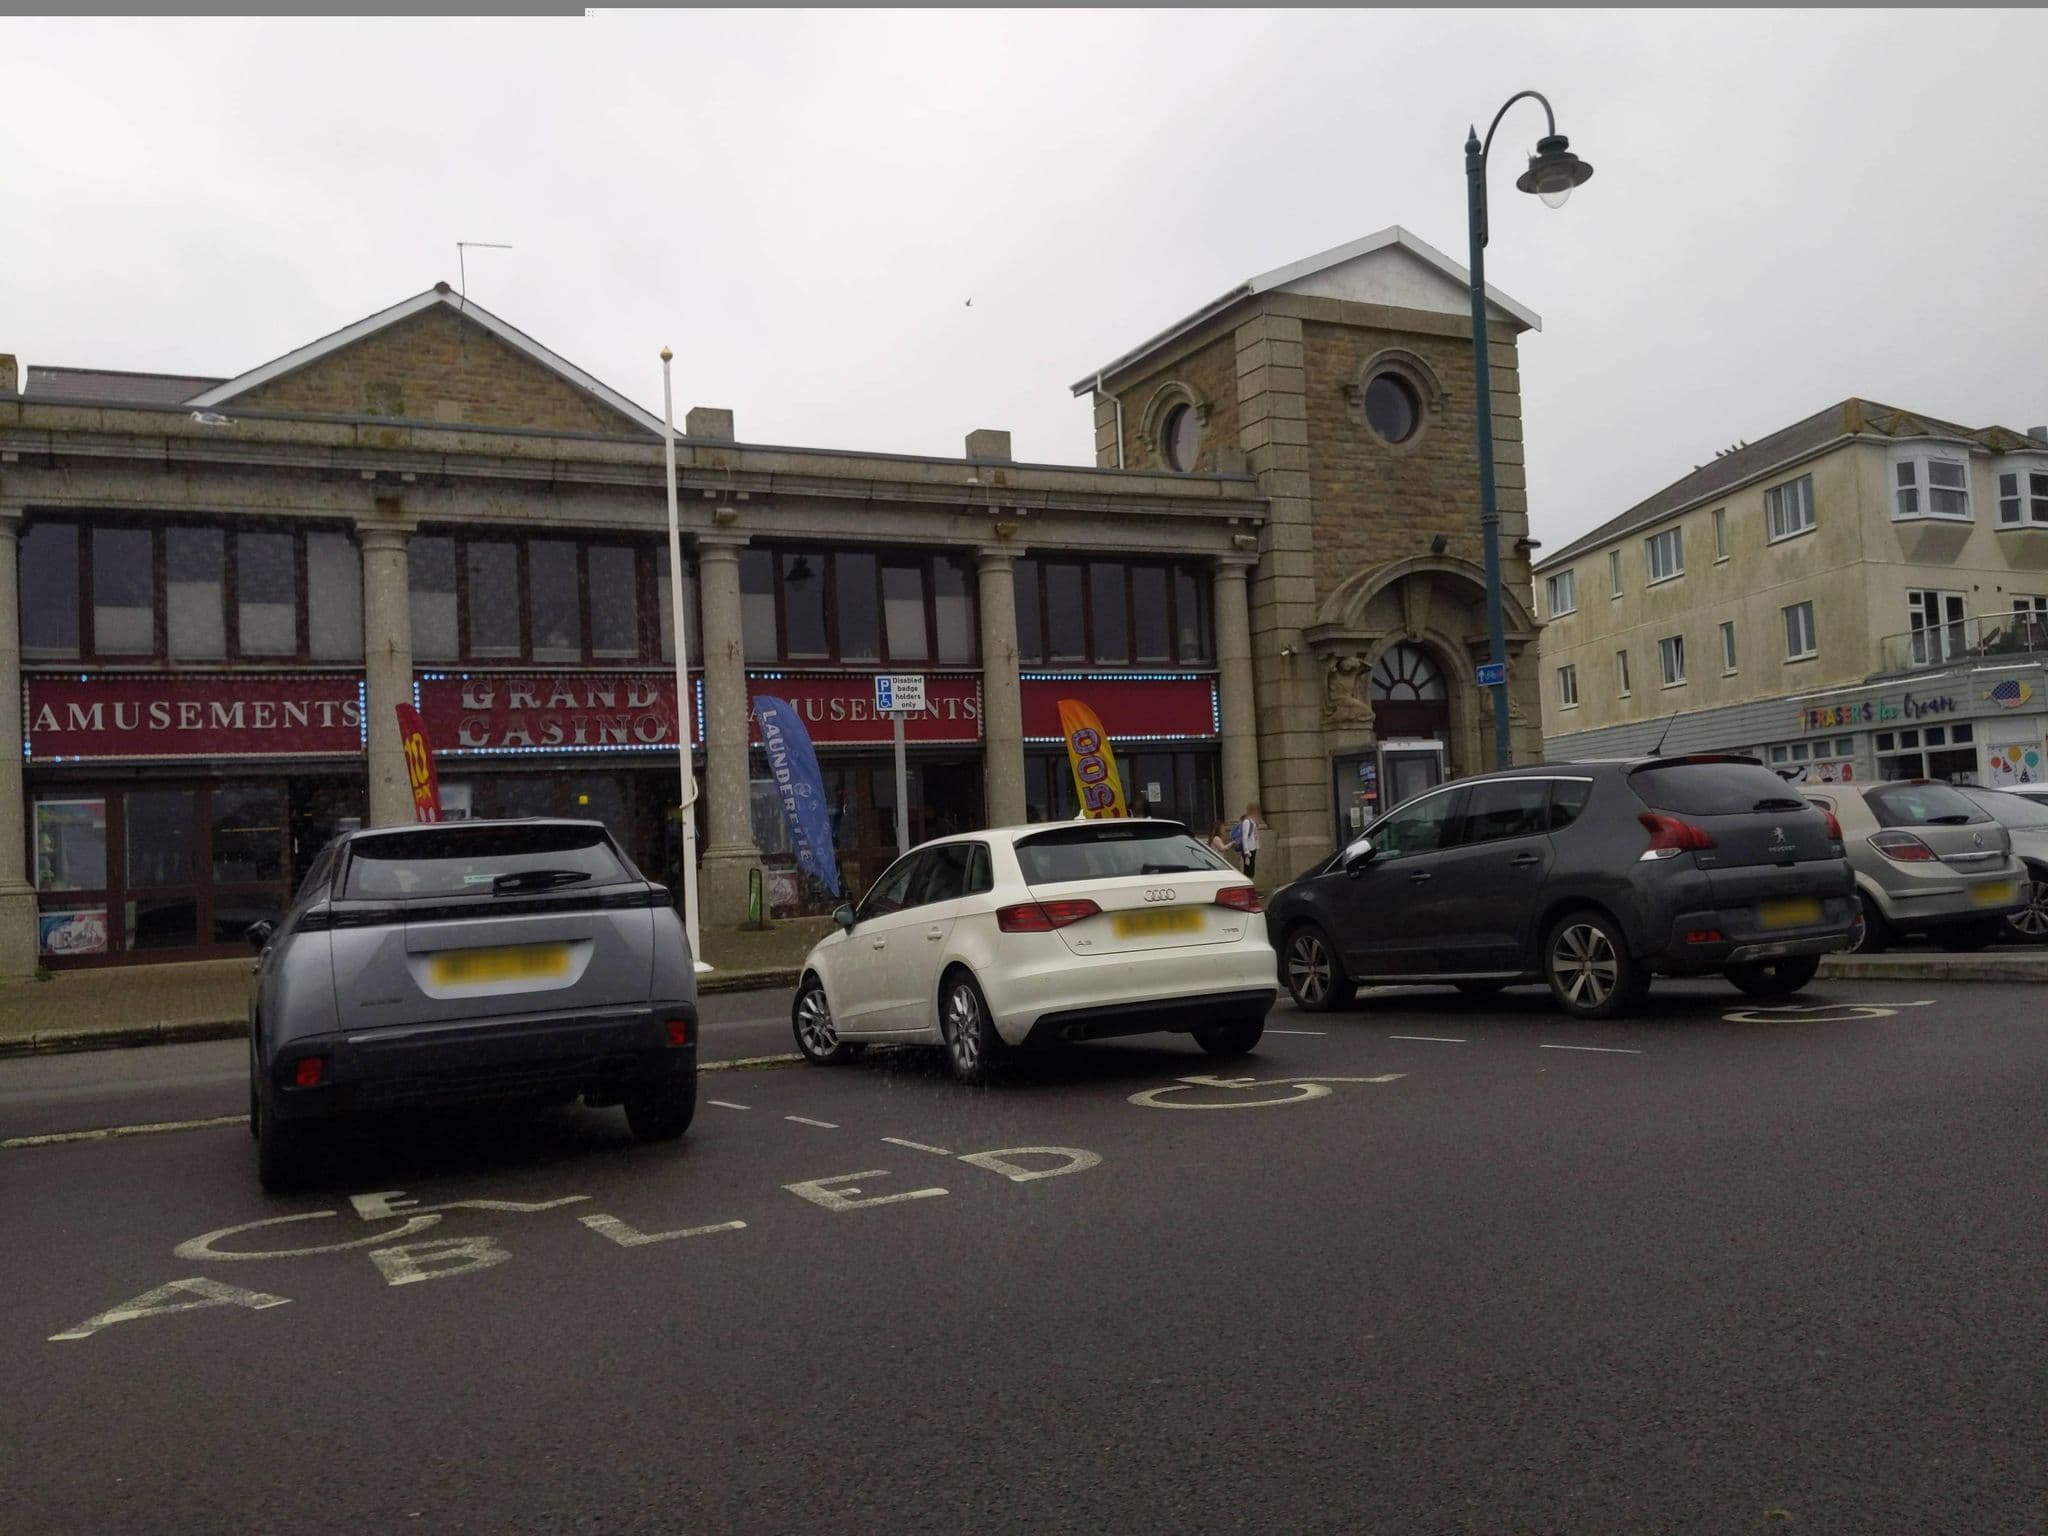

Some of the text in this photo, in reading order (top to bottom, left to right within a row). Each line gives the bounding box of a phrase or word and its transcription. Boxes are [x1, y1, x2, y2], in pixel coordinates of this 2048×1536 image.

[461, 679, 659, 709] GRAND
[31, 700, 360, 732] AMUSEMENTS
[458, 713, 668, 746] CASINO
[1072, 727, 1121, 818] 500
